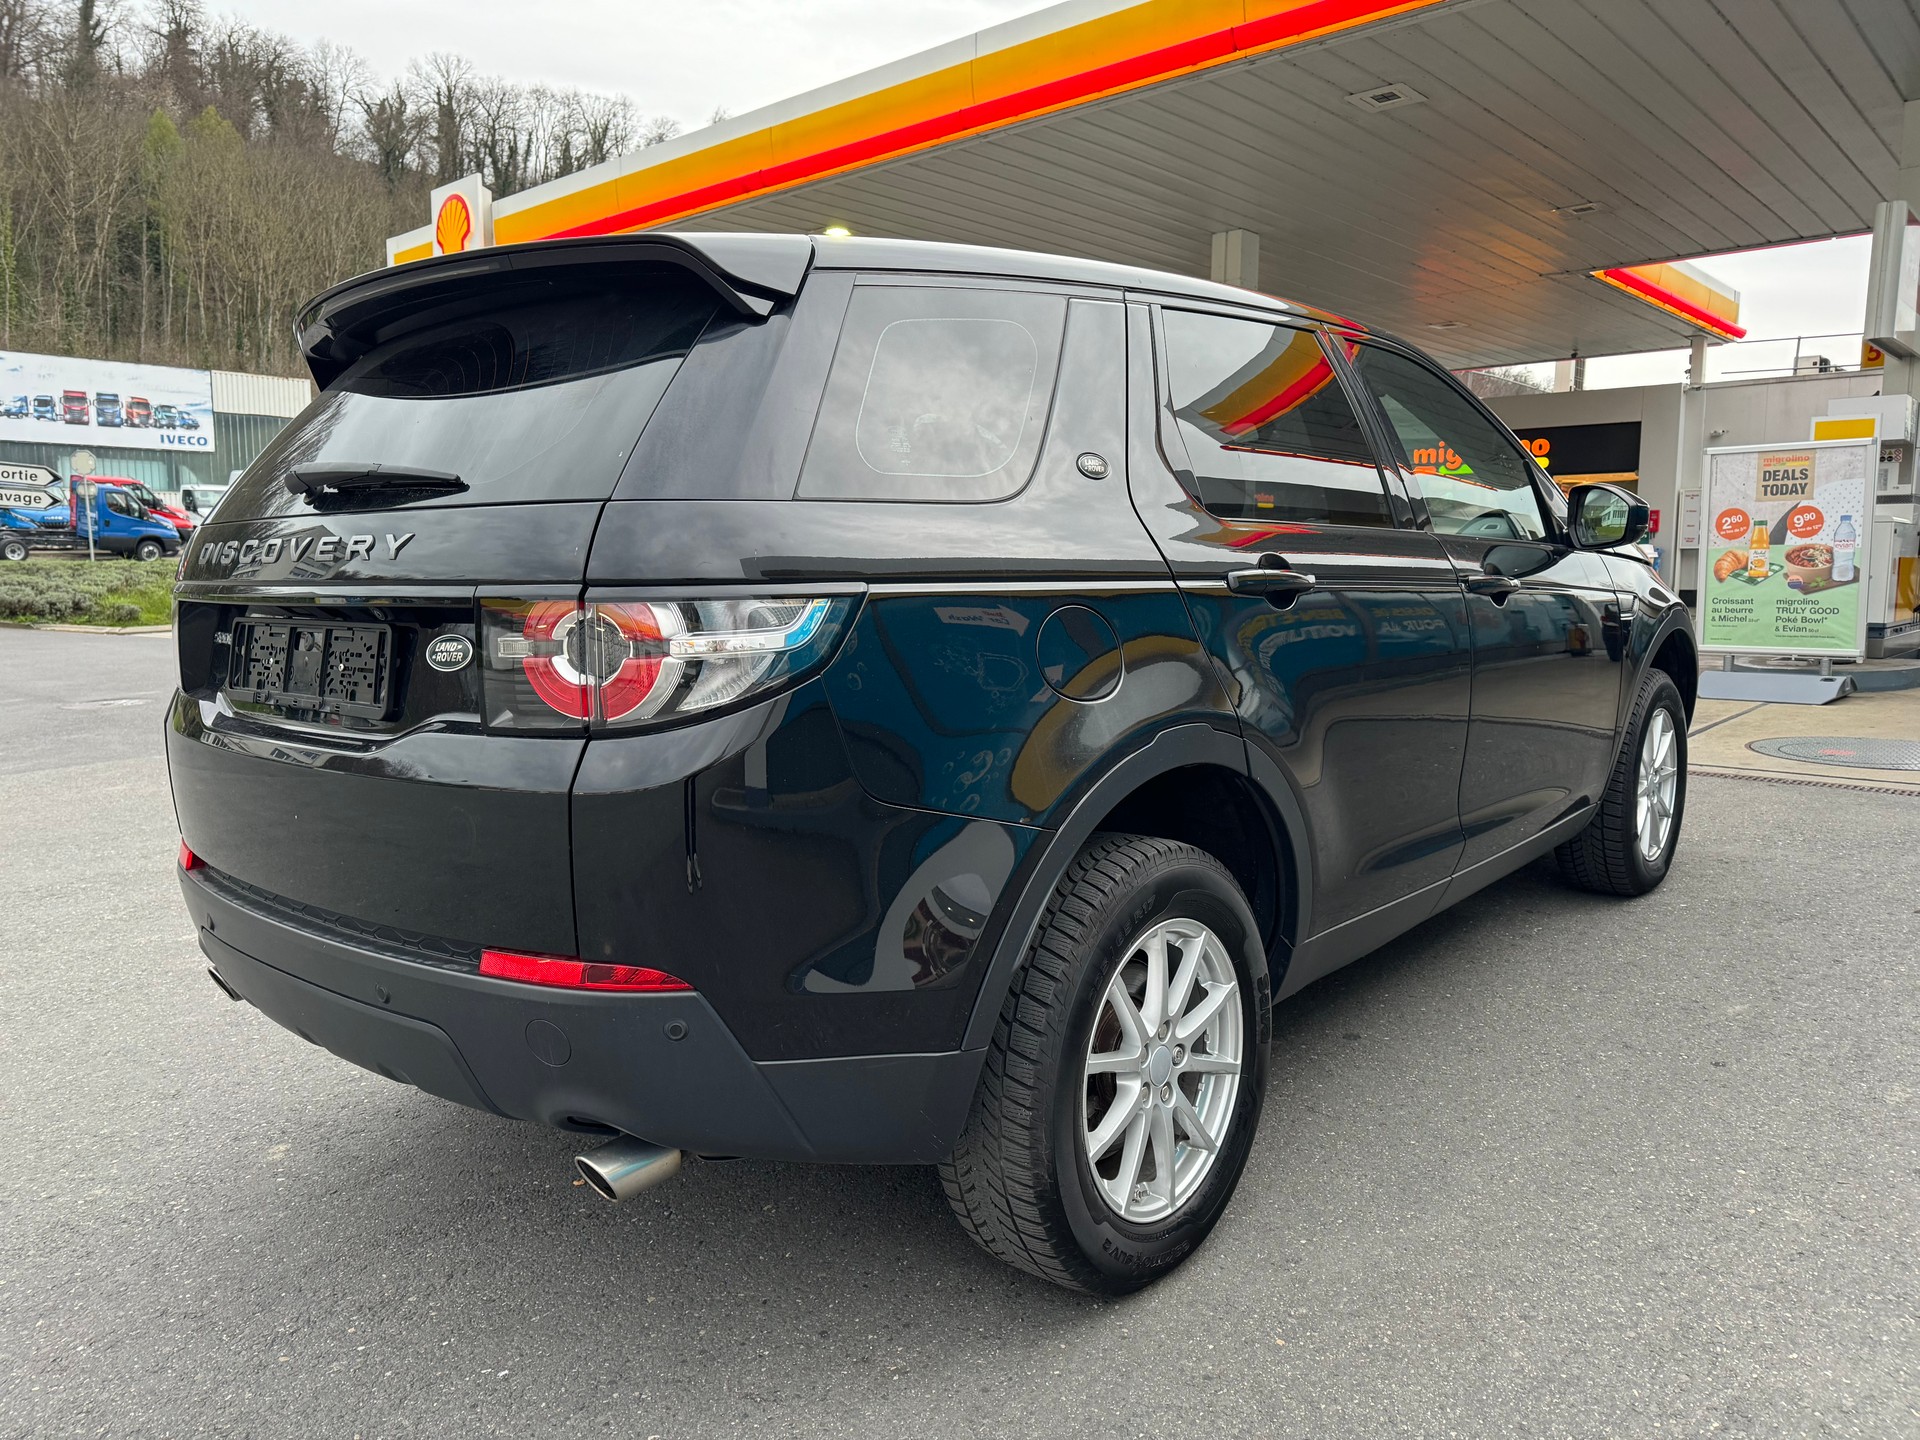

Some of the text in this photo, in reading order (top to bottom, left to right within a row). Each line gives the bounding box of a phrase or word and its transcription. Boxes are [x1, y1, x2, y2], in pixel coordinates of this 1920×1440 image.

[160, 434, 208, 446] IVECO
[1763, 455, 1809, 464] migrolino
[1763, 468, 1809, 482] DEALS
[1761, 482, 1809, 496] TODAY
[198, 532, 416, 565] DISCOVERY
[1711, 597, 1754, 605] Croissant
[1776, 597, 1820, 606] migrolino
[1724, 606, 1754, 614] beurre
[1776, 606, 1840, 615] TRULY GOOD
[1718, 614, 1748, 622] Michel
[1775, 615, 1798, 623] Poké
[1782, 624, 1808, 632] Evian
[435, 641, 458, 652] LAND
[436, 652, 464, 662] ROVER
